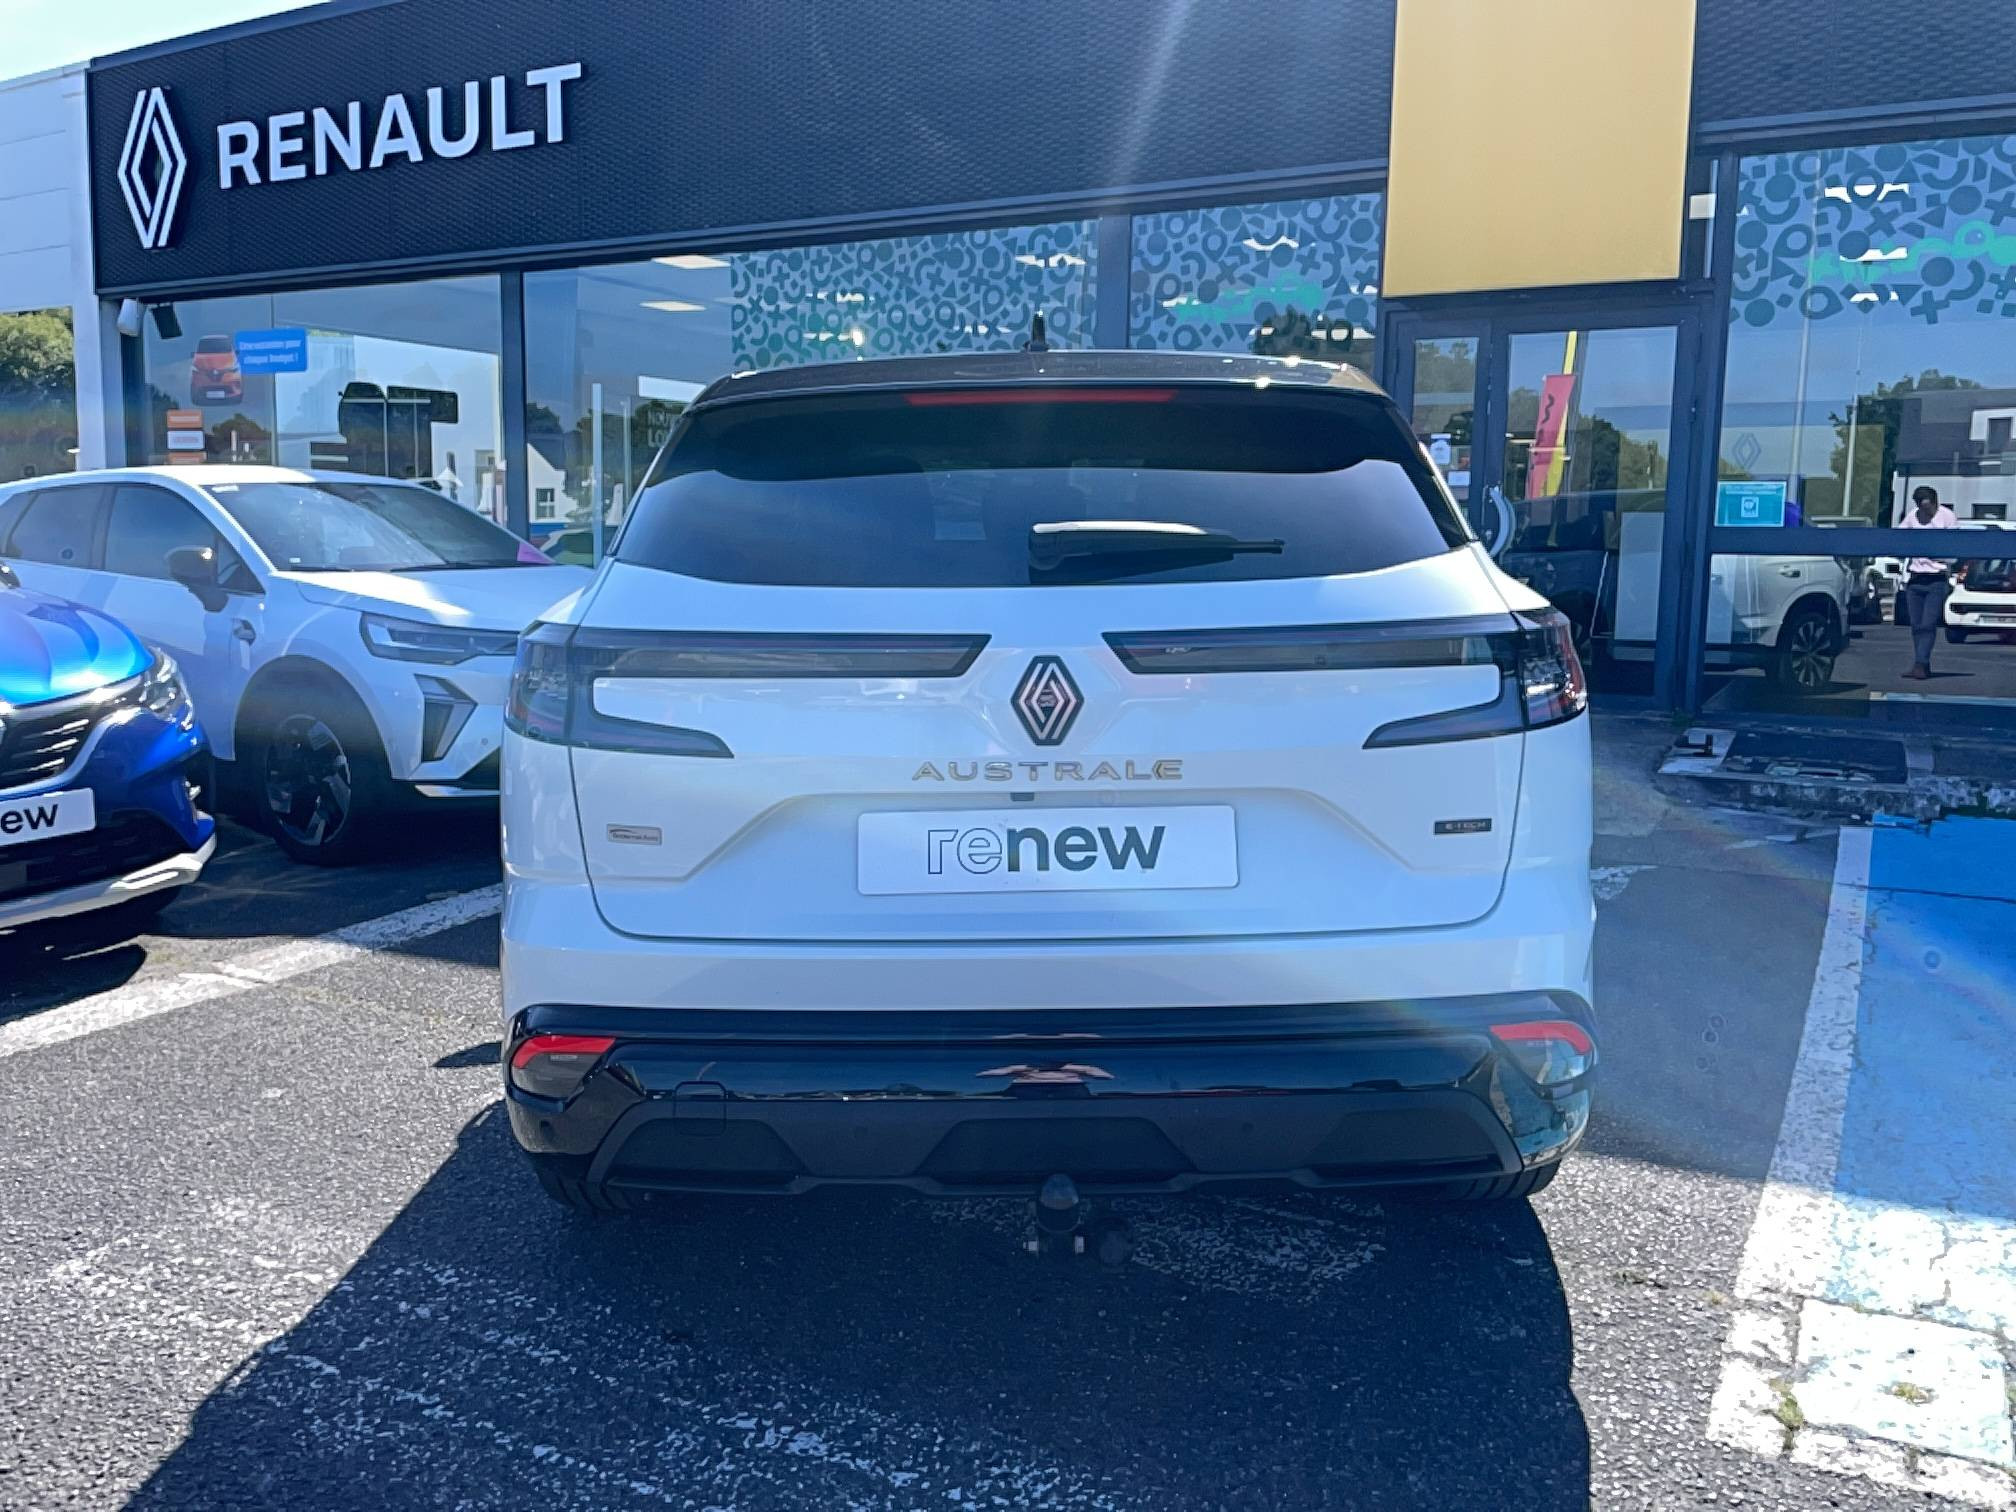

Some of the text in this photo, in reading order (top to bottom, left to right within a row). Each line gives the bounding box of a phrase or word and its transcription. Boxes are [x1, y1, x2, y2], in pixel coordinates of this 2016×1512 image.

[217, 62, 582, 189] RENAULT
[911, 759, 1183, 782] AUSTRALE
[0, 803, 59, 834] ew
[927, 825, 1167, 875] renew
